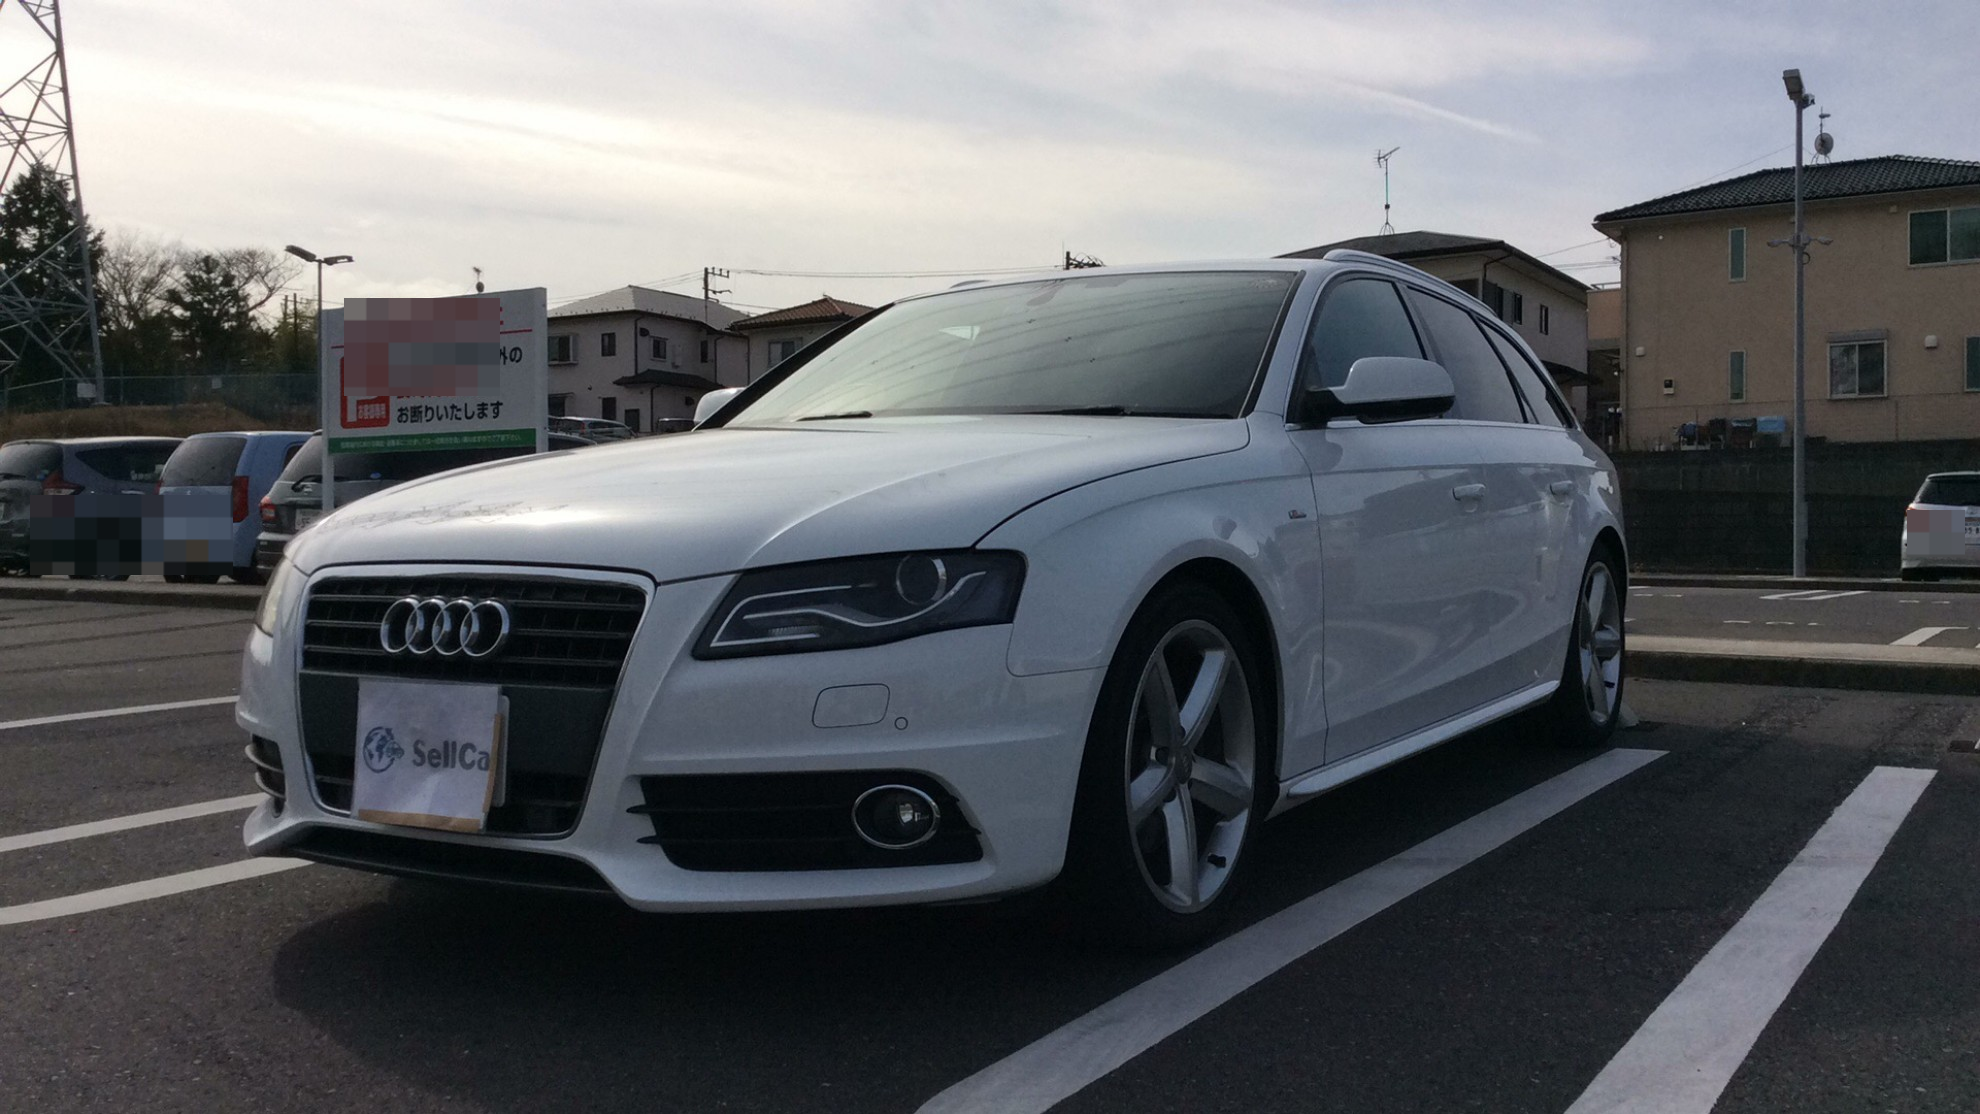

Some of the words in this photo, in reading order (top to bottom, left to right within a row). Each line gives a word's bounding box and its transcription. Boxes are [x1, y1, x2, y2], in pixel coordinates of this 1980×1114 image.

[397, 401, 503, 423] お断りいたします
